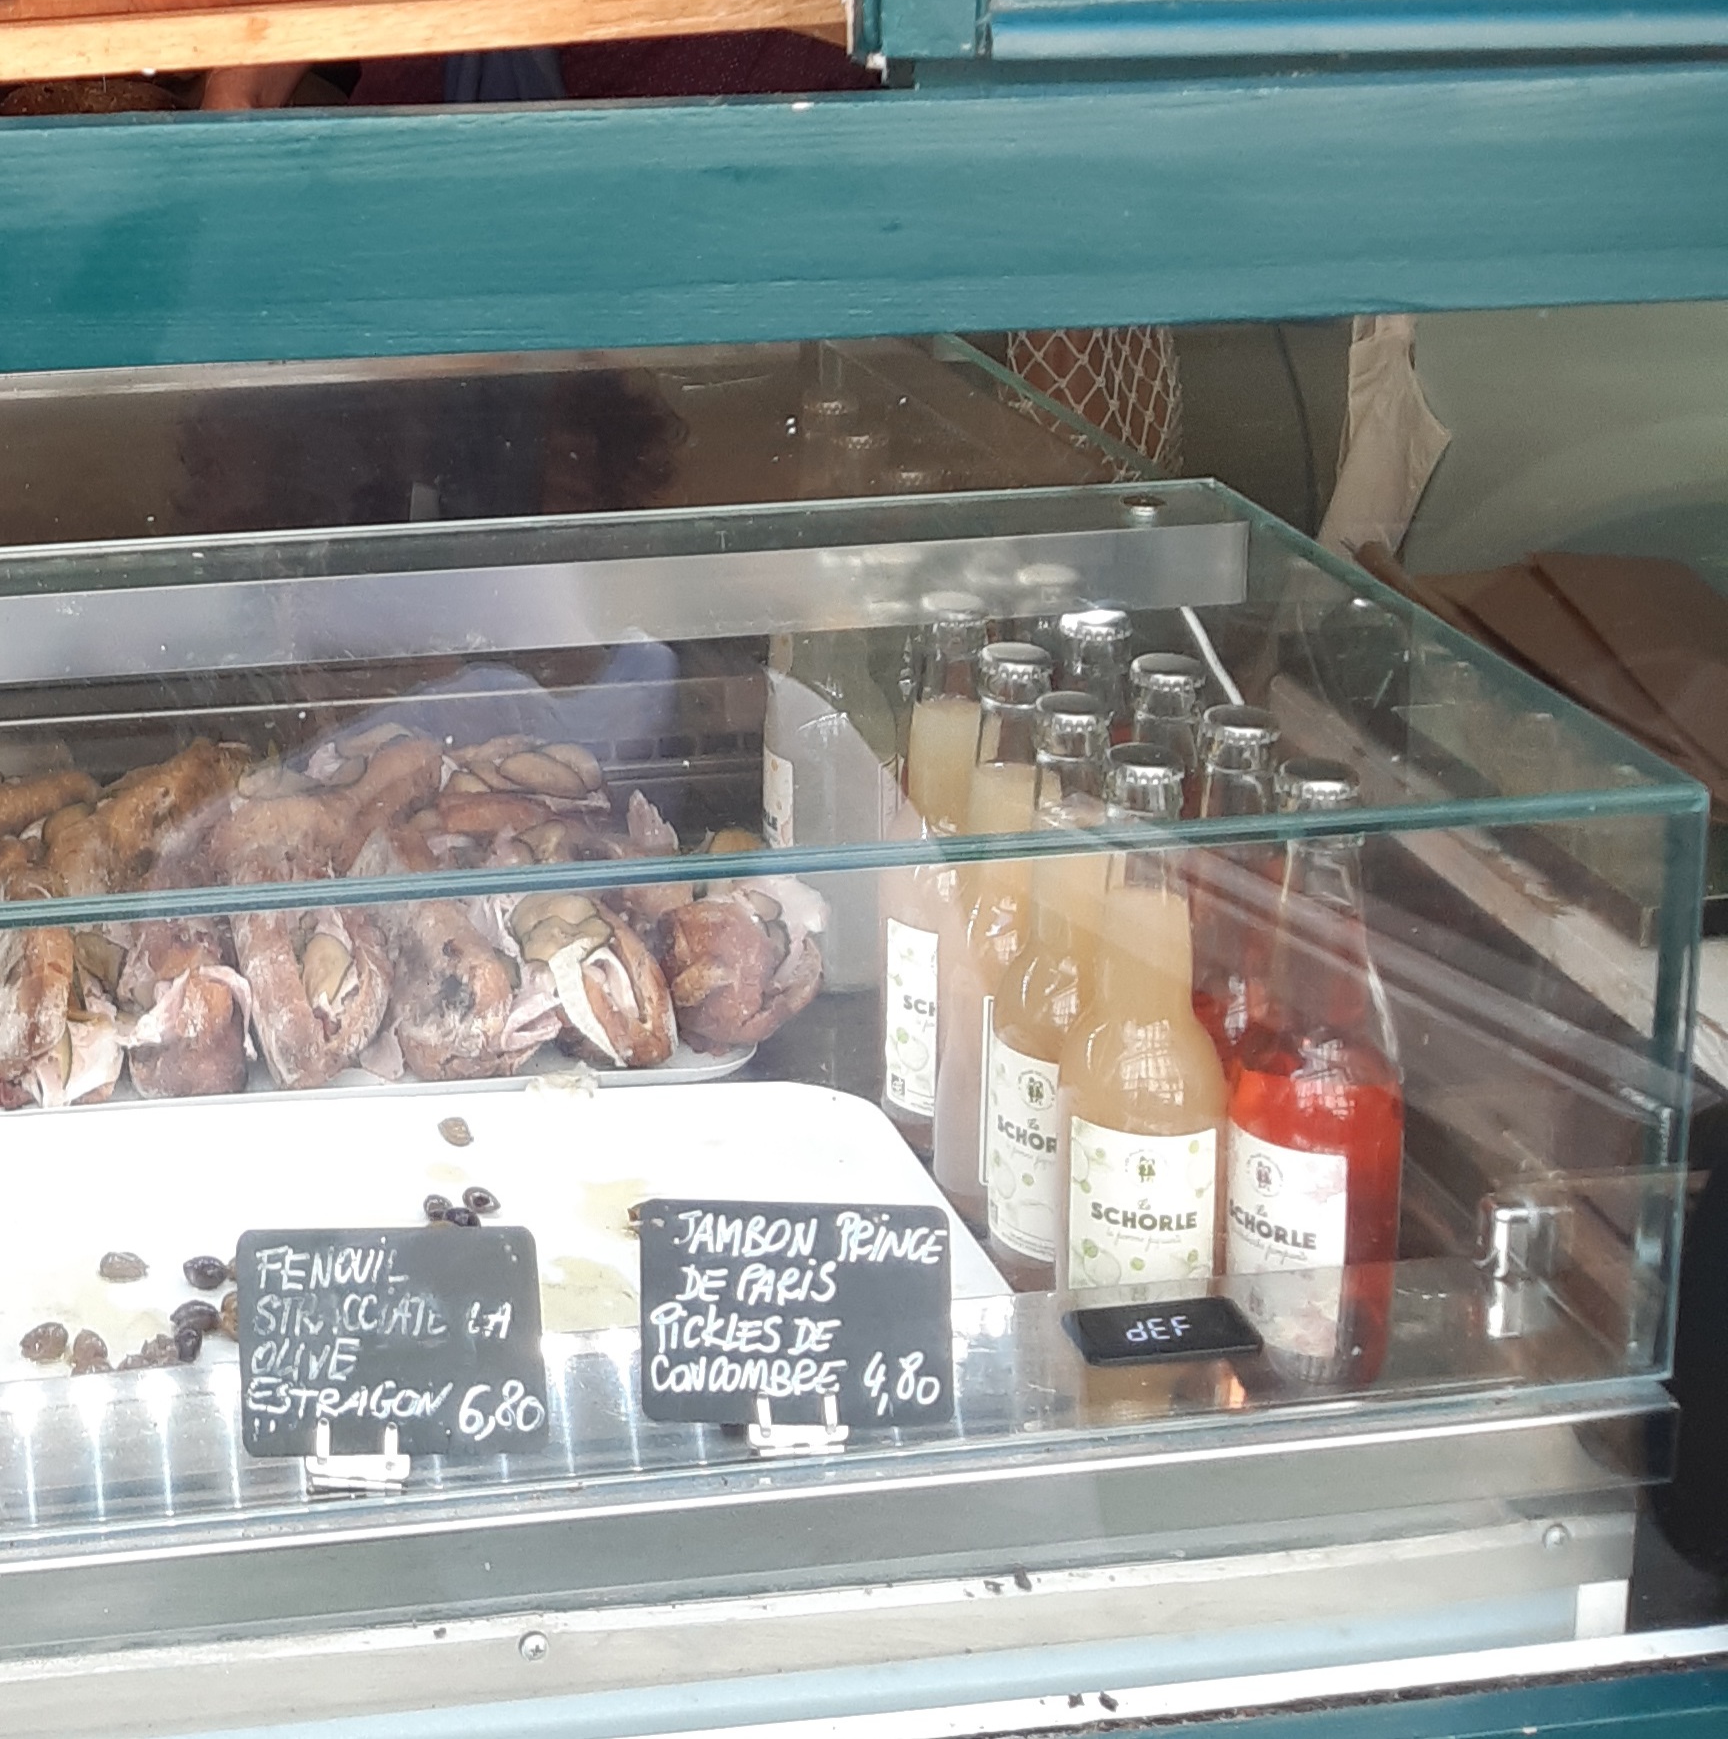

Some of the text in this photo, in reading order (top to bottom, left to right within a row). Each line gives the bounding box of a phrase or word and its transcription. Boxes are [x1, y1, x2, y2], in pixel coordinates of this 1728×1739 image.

[673, 1210, 818, 1258] JAMBON
[835, 1211, 948, 1264] PRINCE
[1091, 1201, 1198, 1232] SCHORLE
[675, 1258, 837, 1305] DE PARIS
[650, 1302, 842, 1355] PICKLES DE
[250, 1337, 361, 1381] OLIVE
[651, 1351, 941, 1416] CONCOMBRE 4,80
[247, 1376, 546, 1441] ESTRAGON 6,80
